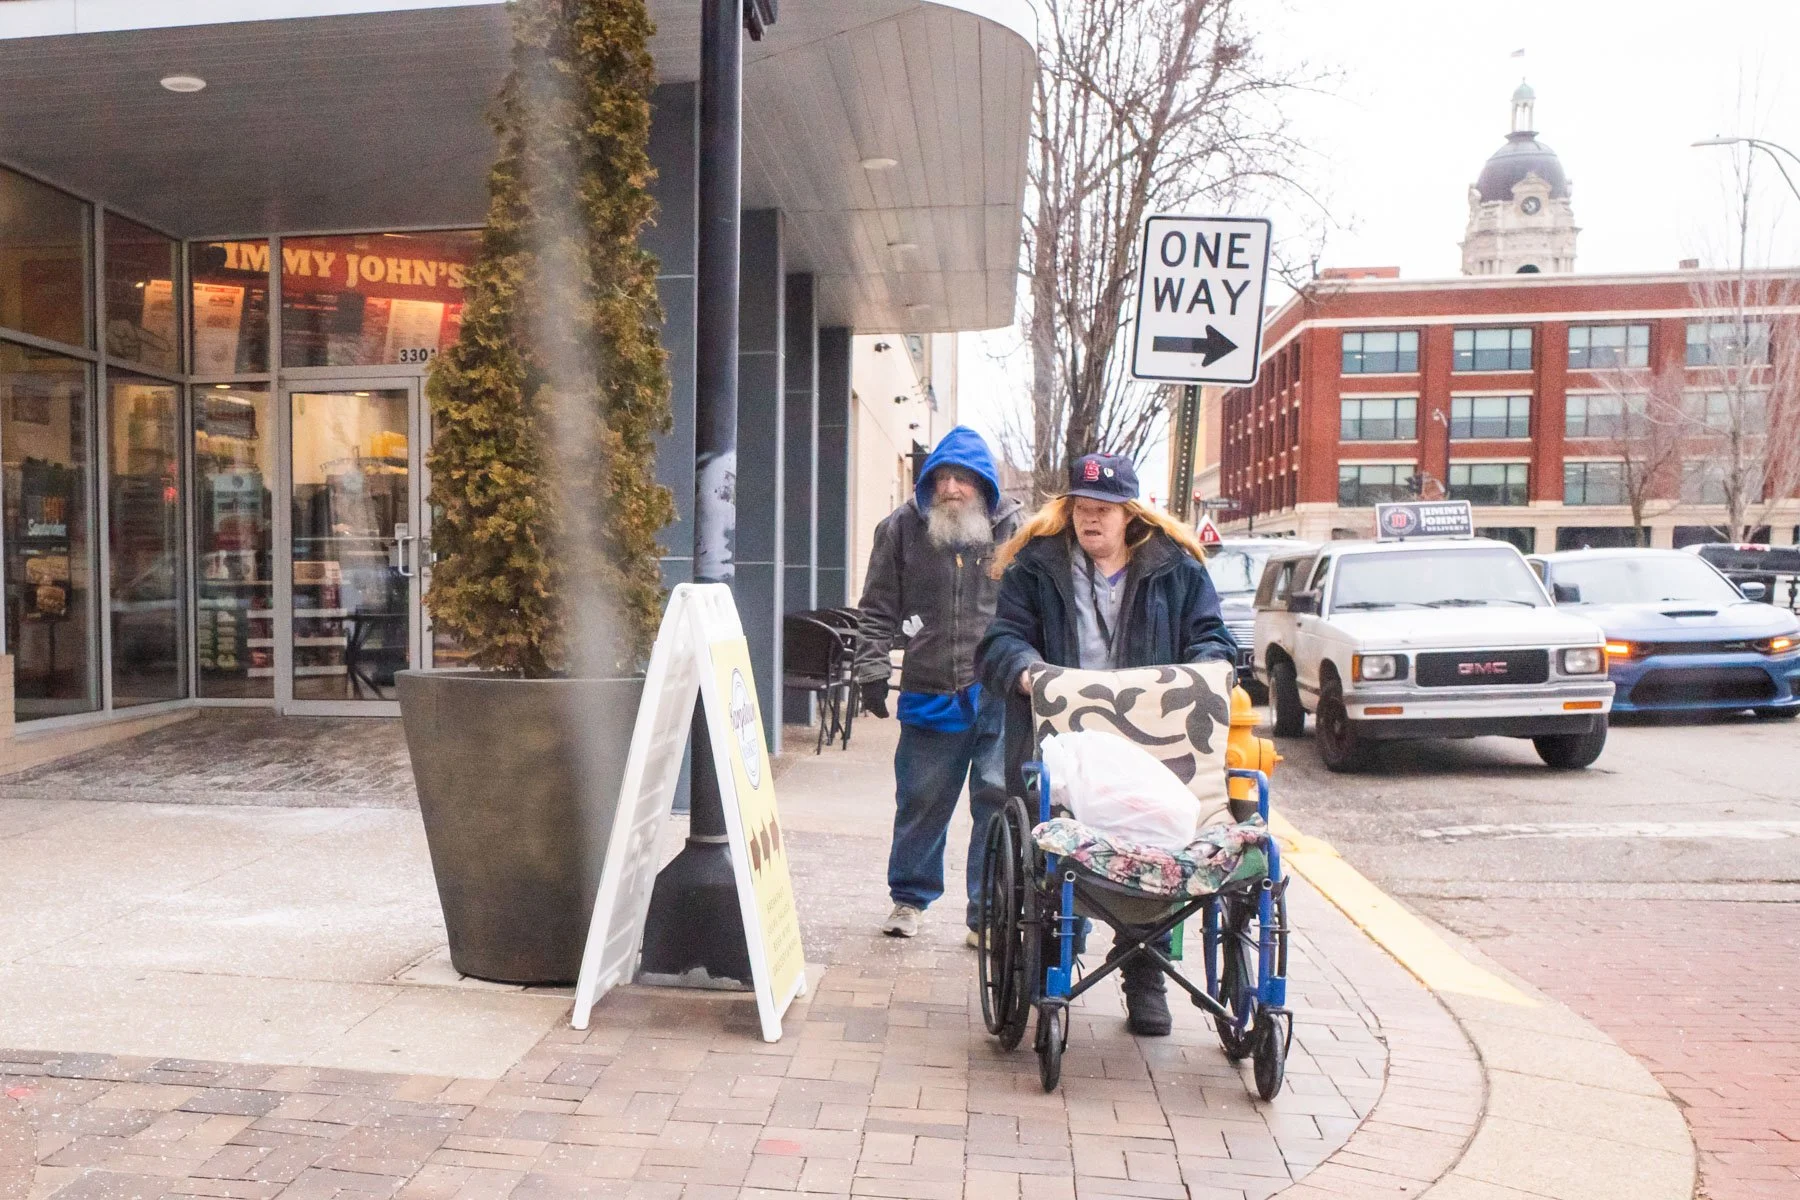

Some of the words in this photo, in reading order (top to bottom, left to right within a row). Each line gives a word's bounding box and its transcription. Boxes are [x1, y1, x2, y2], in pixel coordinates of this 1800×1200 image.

[1161, 230, 1251, 269] ONE
[209, 242, 336, 278] IMMY
[346, 254, 464, 288] JOHN'S
[1154, 277, 1252, 316] WAY
[400, 348, 435, 362] 330
[1419, 506, 1467, 516] JIMMY
[1420, 515, 1468, 528] JOHN'S
[1458, 661, 1508, 675] GMC
